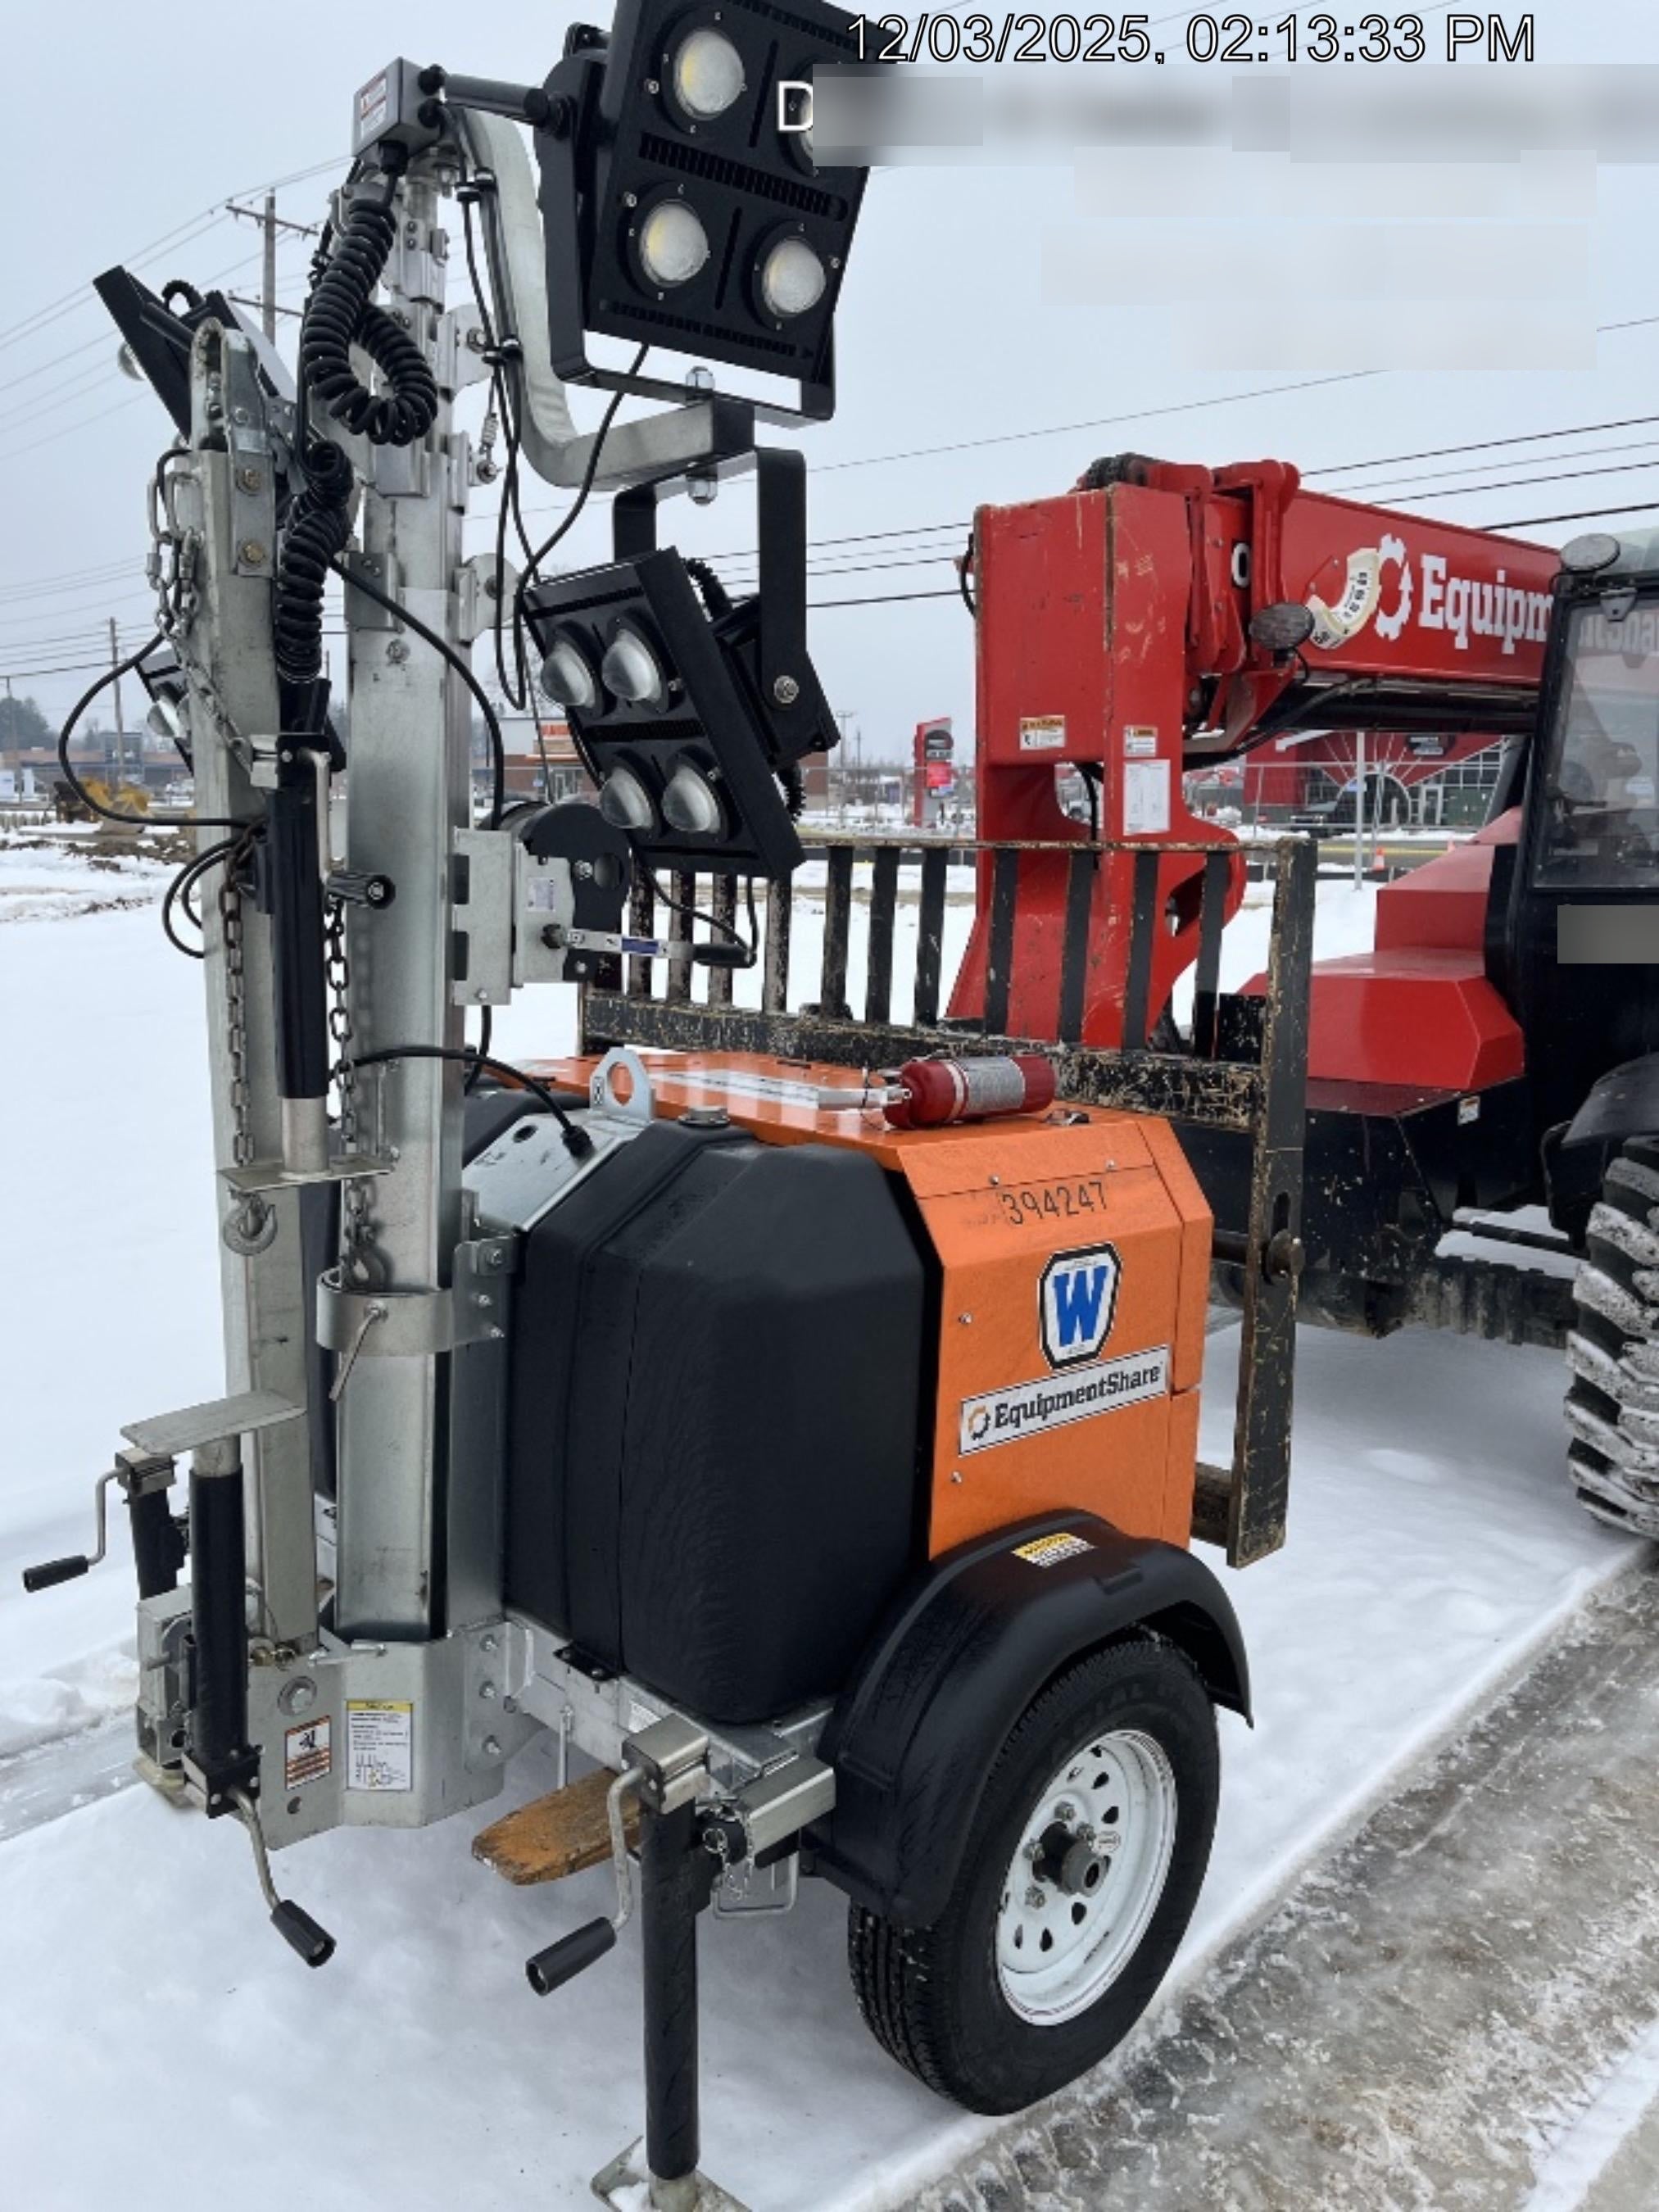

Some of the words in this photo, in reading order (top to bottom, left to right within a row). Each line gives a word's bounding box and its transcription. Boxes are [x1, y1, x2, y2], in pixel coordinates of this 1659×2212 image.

[1002, 1181, 1107, 1225] 394247
[1054, 1266, 1108, 1347] W
[994, 1364, 1161, 1430] EquipmentShare
